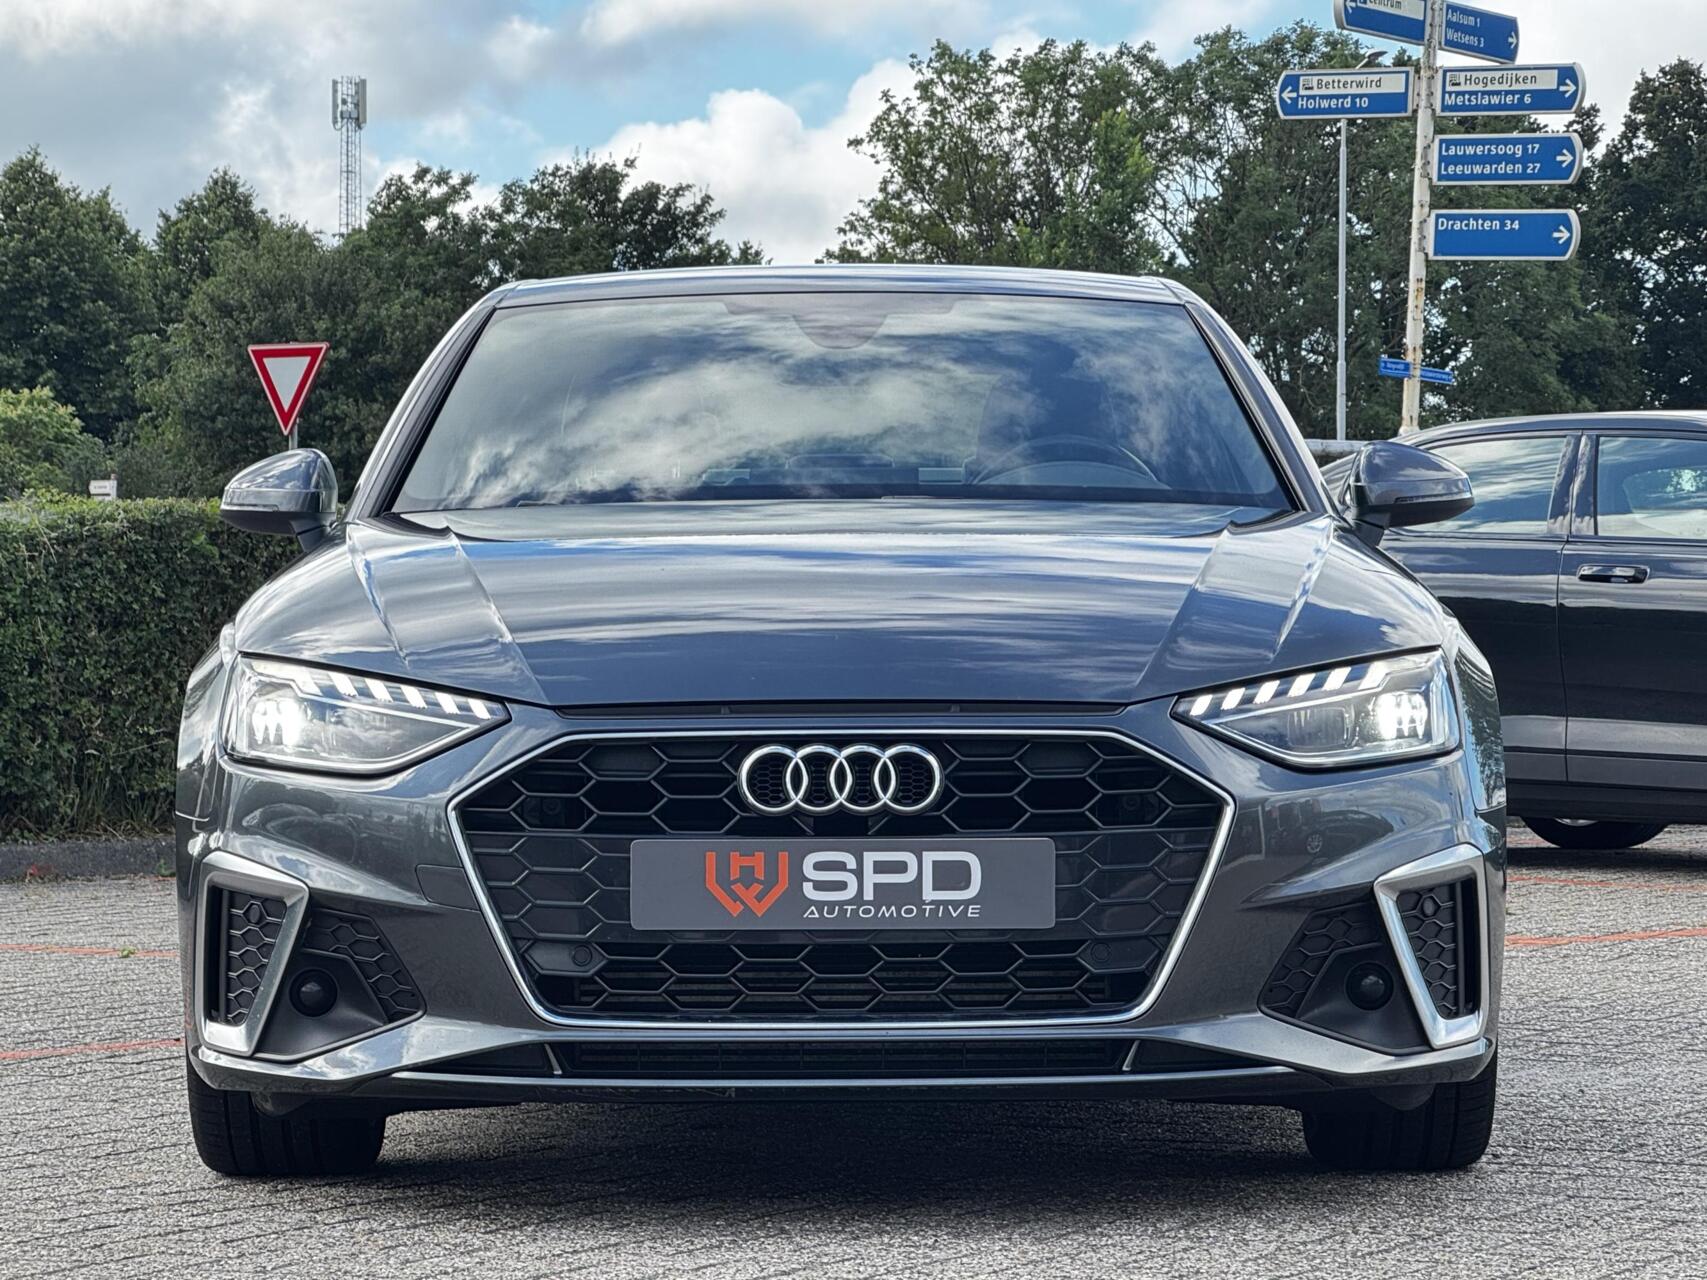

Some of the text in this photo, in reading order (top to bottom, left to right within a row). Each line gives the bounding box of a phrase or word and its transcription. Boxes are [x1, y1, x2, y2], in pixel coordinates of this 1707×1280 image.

[1447, 9, 1480, 28] Aalsum 1
[1446, 27, 1485, 47] Wetsens 3
[1316, 77, 1382, 90] Betterwird
[1464, 73, 1537, 88] Hogedijken
[1298, 95, 1369, 109] Holwerd 10
[1444, 91, 1532, 106] Metslawier 6
[1441, 142, 1540, 158] Lauwersoog 17
[1441, 161, 1541, 175] Leeuwarden 27
[1438, 217, 1519, 231] Drachten 34
[802, 851, 982, 901] SPD
[802, 904, 982, 918] AUTOMOTIVE
